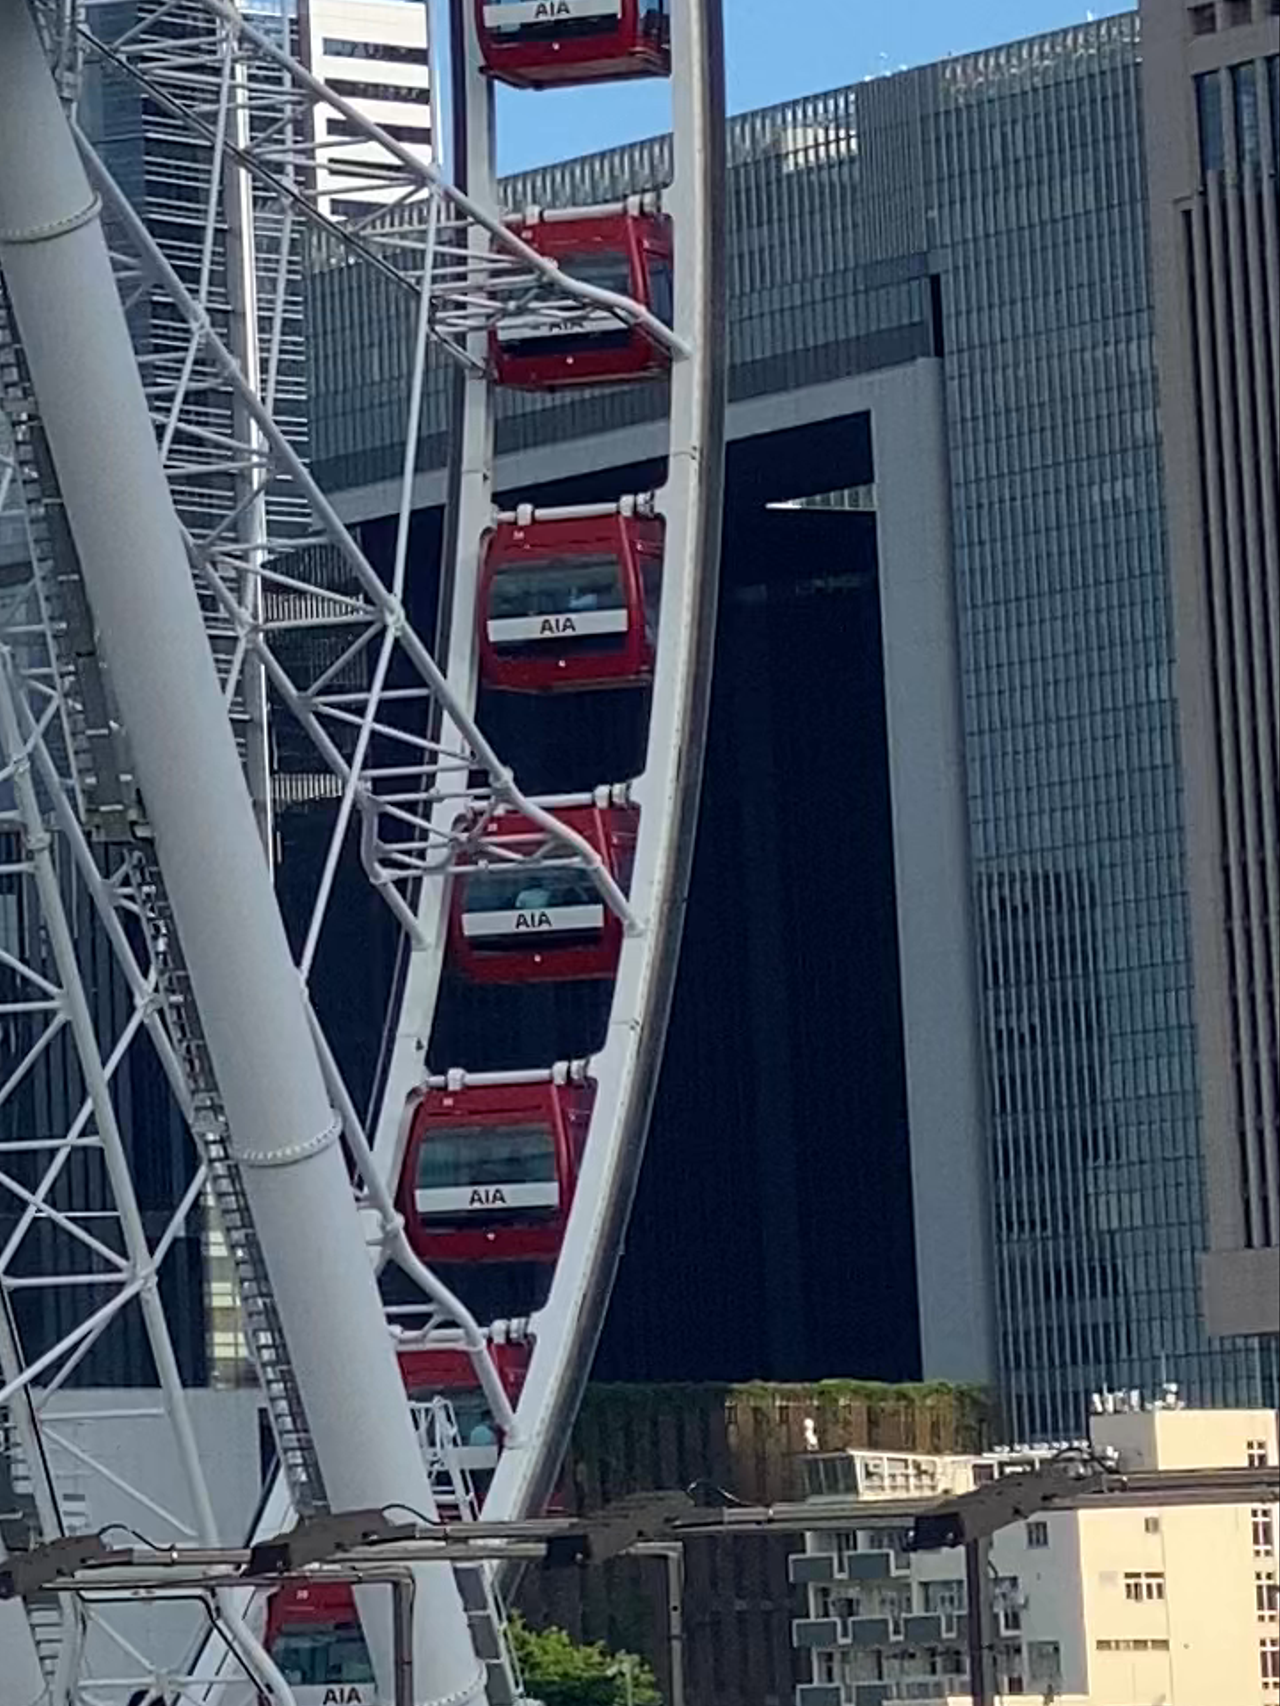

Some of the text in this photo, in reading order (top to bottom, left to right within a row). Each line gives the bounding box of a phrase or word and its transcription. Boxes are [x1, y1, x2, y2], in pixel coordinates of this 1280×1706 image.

[534, 0, 571, 19] AIA
[540, 615, 576, 635] AIA
[515, 910, 552, 932] AIA
[469, 1187, 506, 1207] AIA
[322, 1687, 362, 1706] AIA
